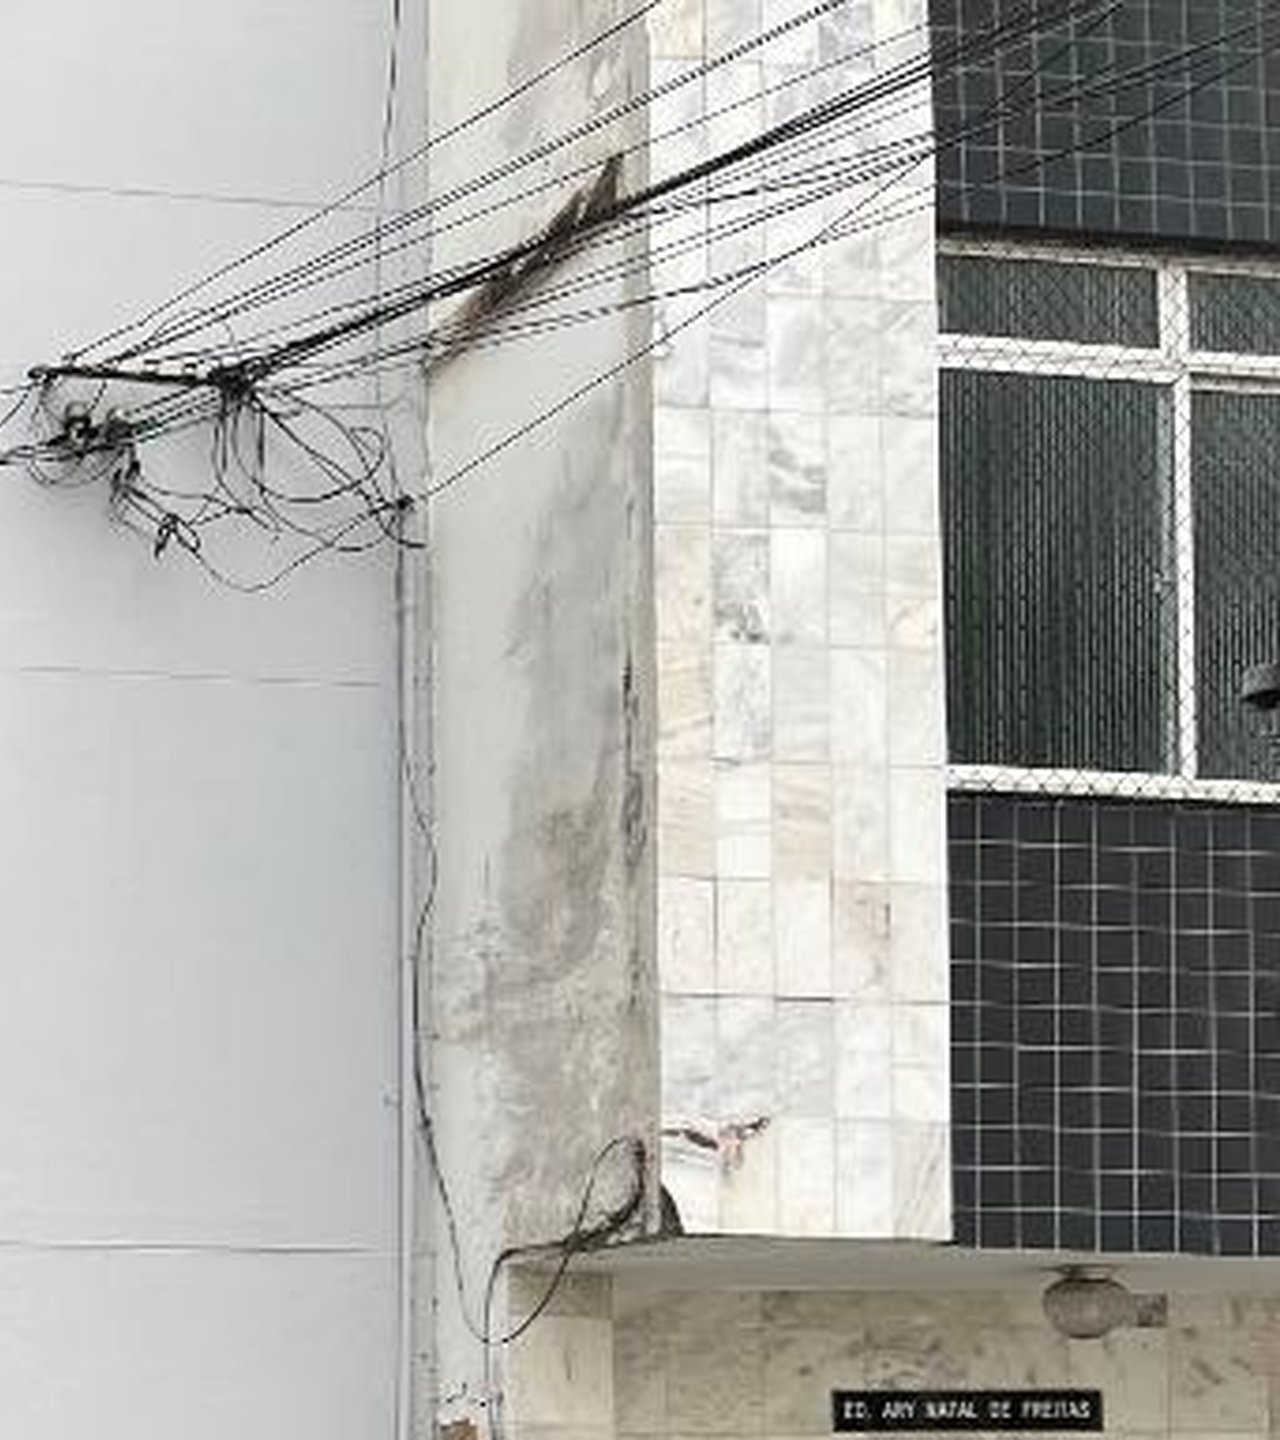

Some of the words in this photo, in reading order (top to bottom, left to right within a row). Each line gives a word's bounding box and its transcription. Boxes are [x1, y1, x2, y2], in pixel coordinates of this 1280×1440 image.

[881, 1401, 916, 1419] ARY
[925, 1401, 979, 1419] NATAL
[989, 1401, 1012, 1419] DE
[1020, 1401, 1091, 1419] FREITAS
